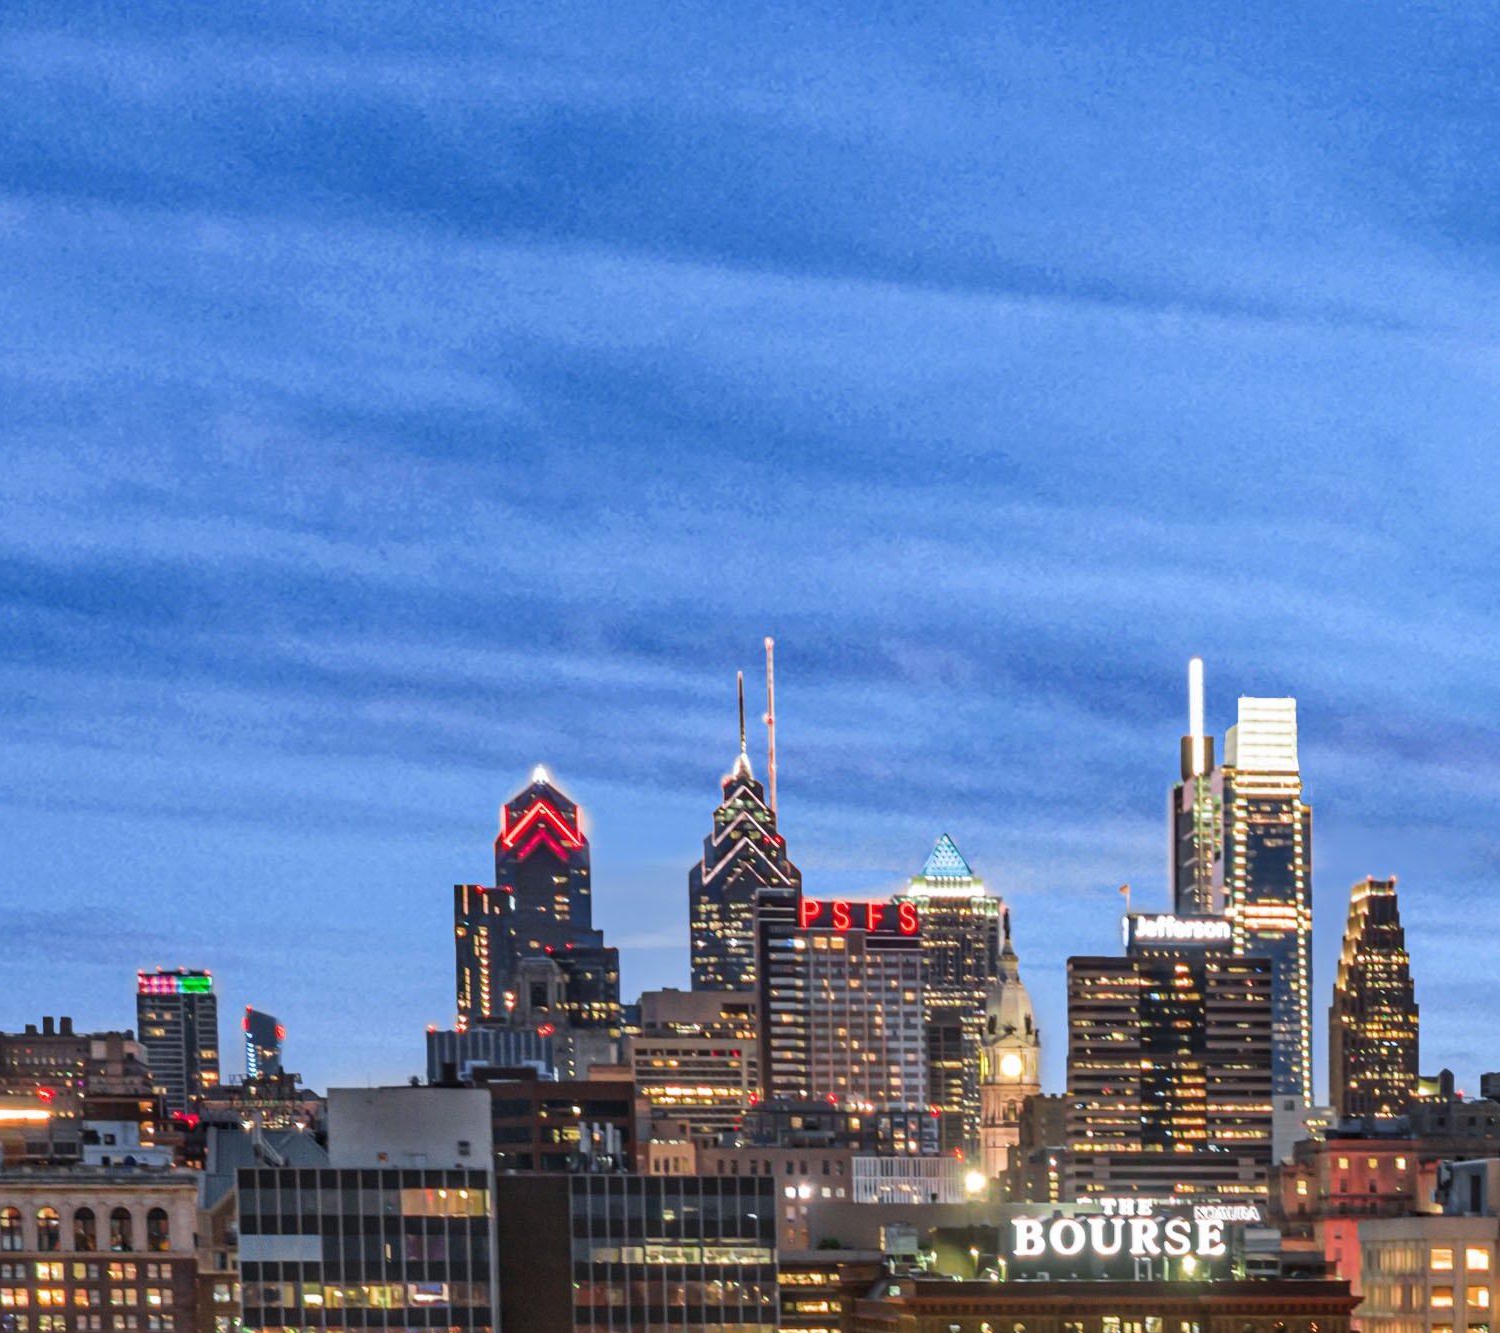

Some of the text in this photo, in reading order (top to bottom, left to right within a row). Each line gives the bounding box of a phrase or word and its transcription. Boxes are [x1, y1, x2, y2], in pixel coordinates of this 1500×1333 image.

[800, 897, 918, 935] PSFS
[1135, 915, 1231, 938] Jefferson
[1100, 1197, 1152, 1215] THE
[1012, 1217, 1226, 1255] BOURSE
